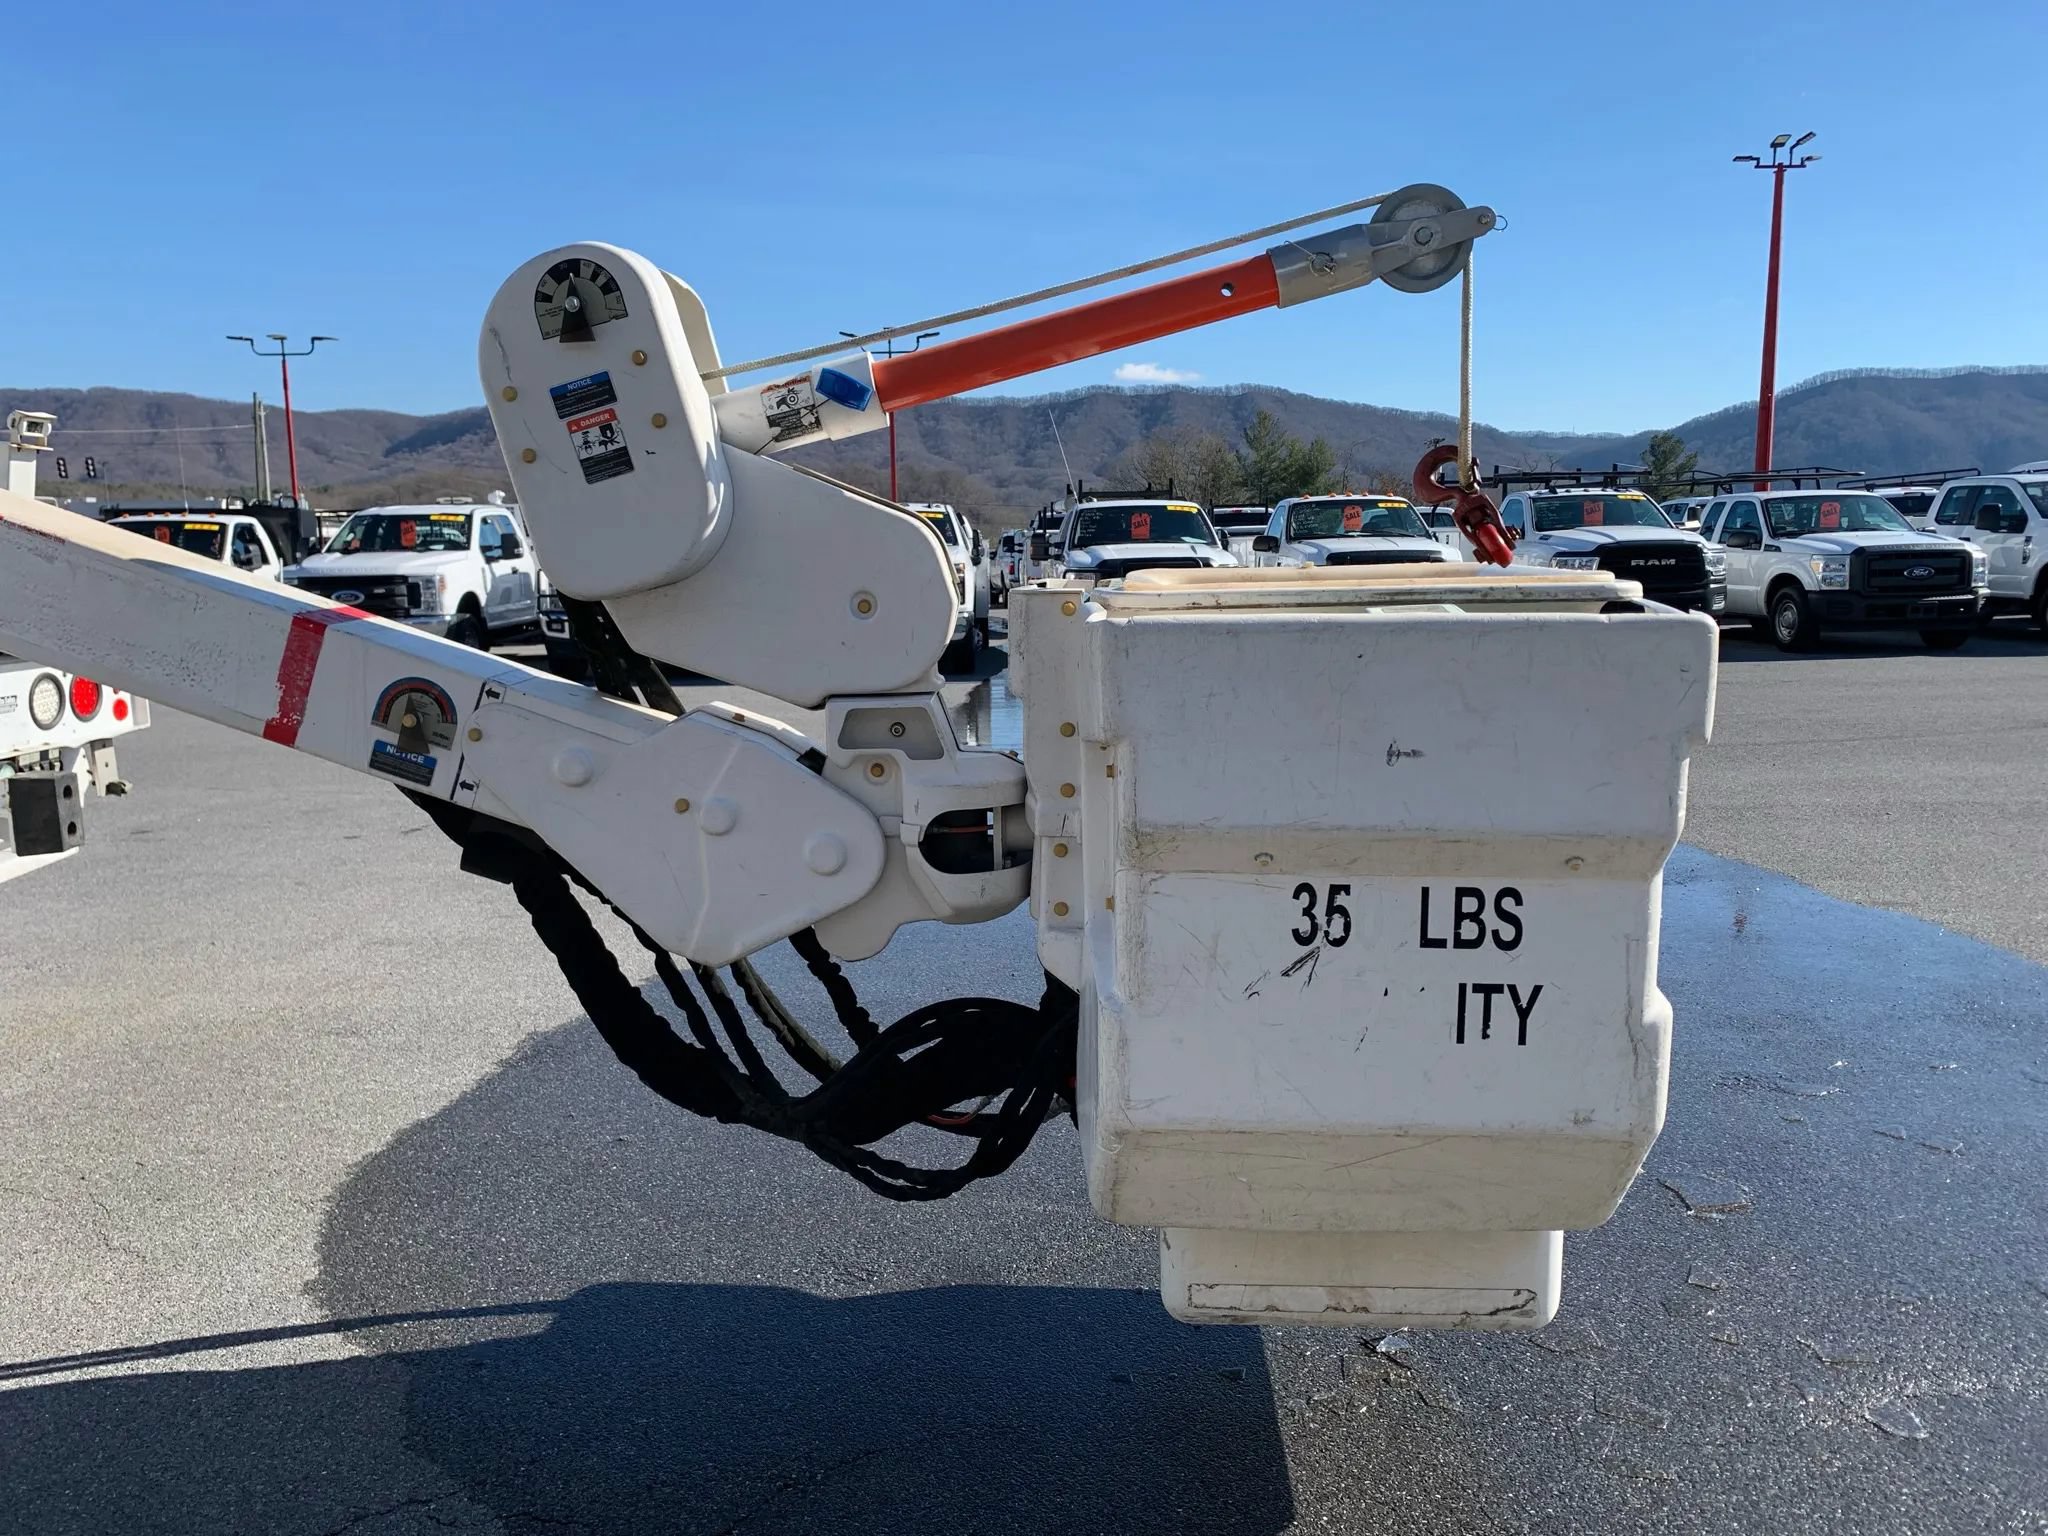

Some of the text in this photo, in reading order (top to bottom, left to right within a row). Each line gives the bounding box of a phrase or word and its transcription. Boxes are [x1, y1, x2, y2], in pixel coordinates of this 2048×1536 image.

[567, 378, 592, 391] NOTICE
[580, 413, 610, 427] DANGER
[1344, 511, 1362, 522] SALE
[1133, 519, 1149, 529] SALE
[1630, 559, 1677, 567] RAM
[1291, 882, 1524, 952] 35 LBS
[1456, 982, 1544, 1046] ITY
